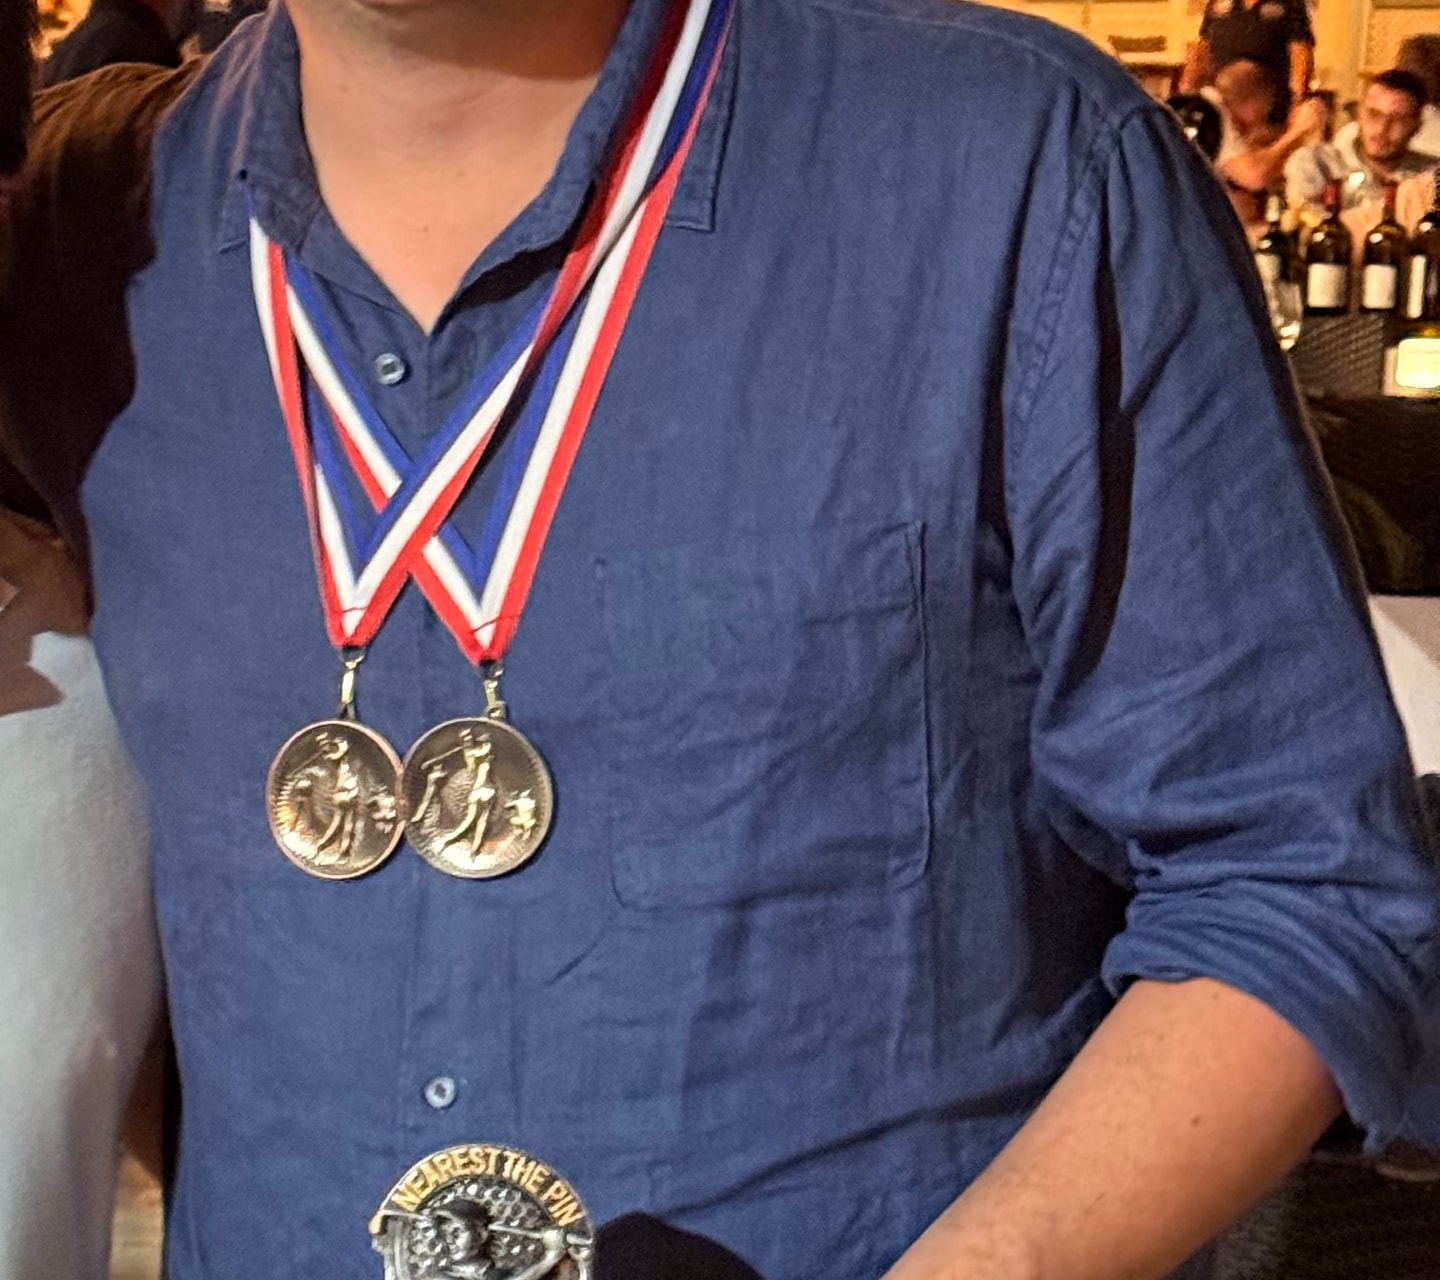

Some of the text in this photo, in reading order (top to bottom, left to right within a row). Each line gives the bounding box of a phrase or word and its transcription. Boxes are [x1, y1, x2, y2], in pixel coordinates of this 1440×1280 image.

[390, 1146, 587, 1228] NEAREST THE PIN
